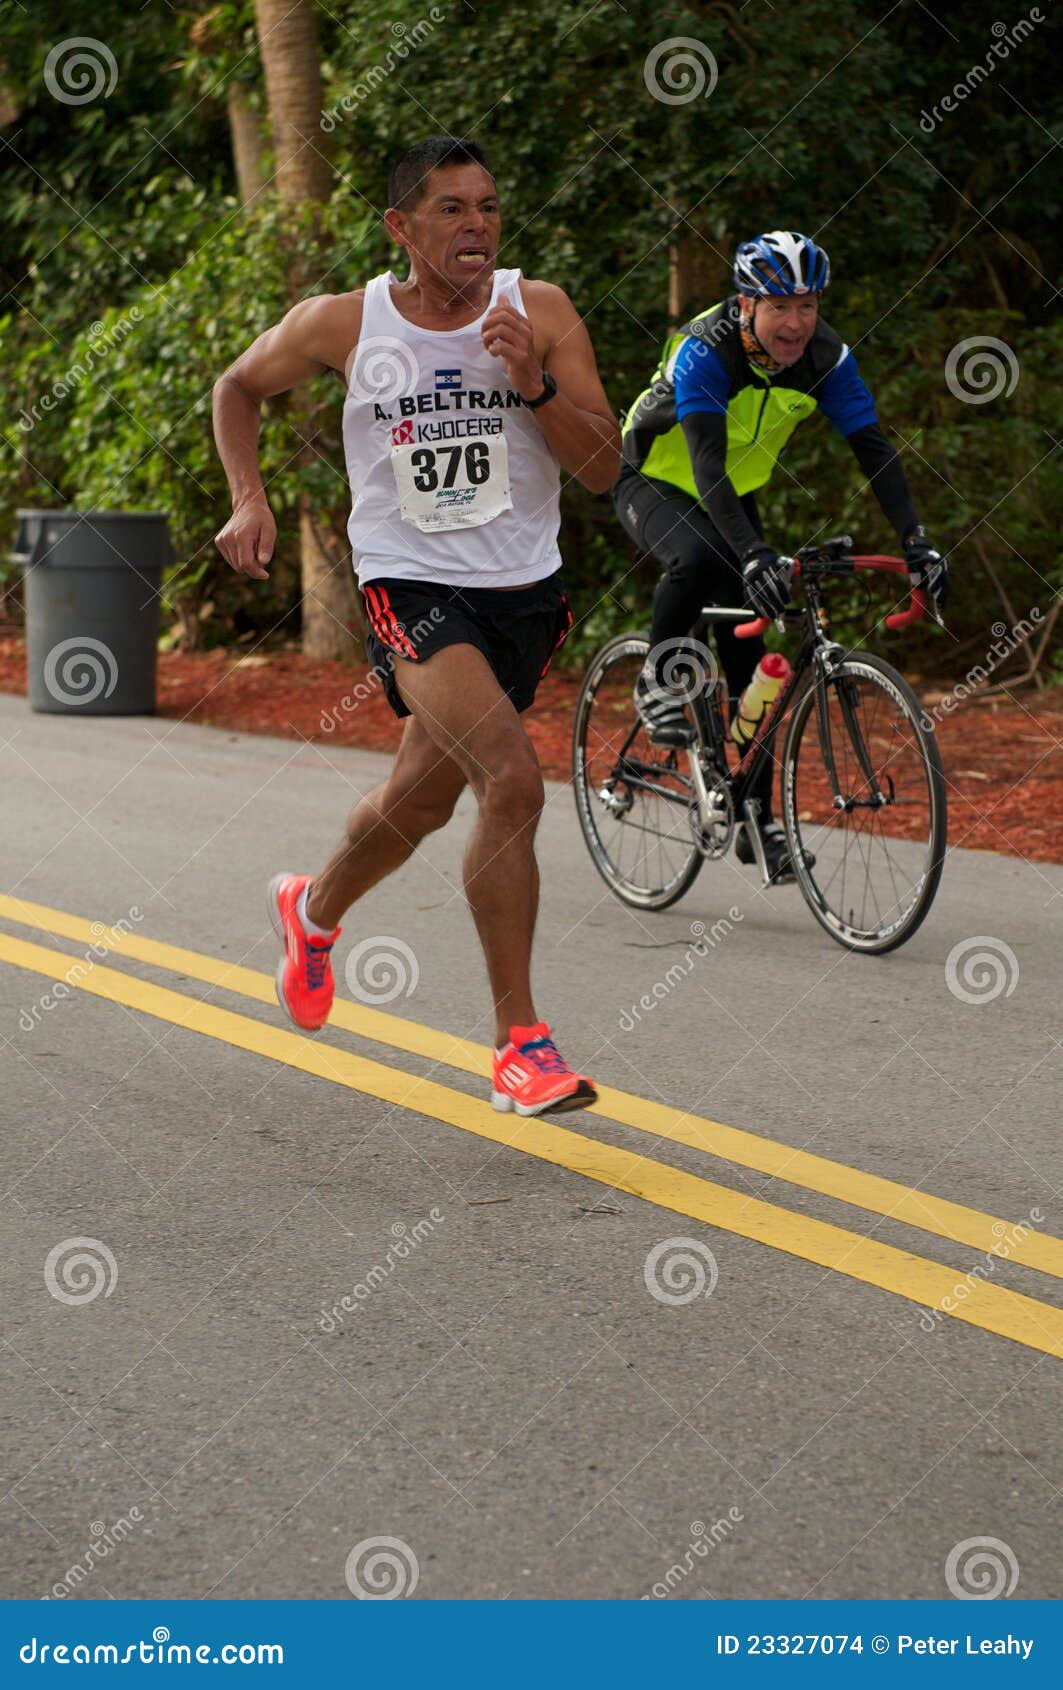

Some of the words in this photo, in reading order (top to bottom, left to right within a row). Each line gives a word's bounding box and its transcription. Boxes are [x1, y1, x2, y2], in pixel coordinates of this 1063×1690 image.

[374, 403, 393, 421] A.
[399, 390, 521, 417] BELTRAN
[411, 442, 490, 493] 376
